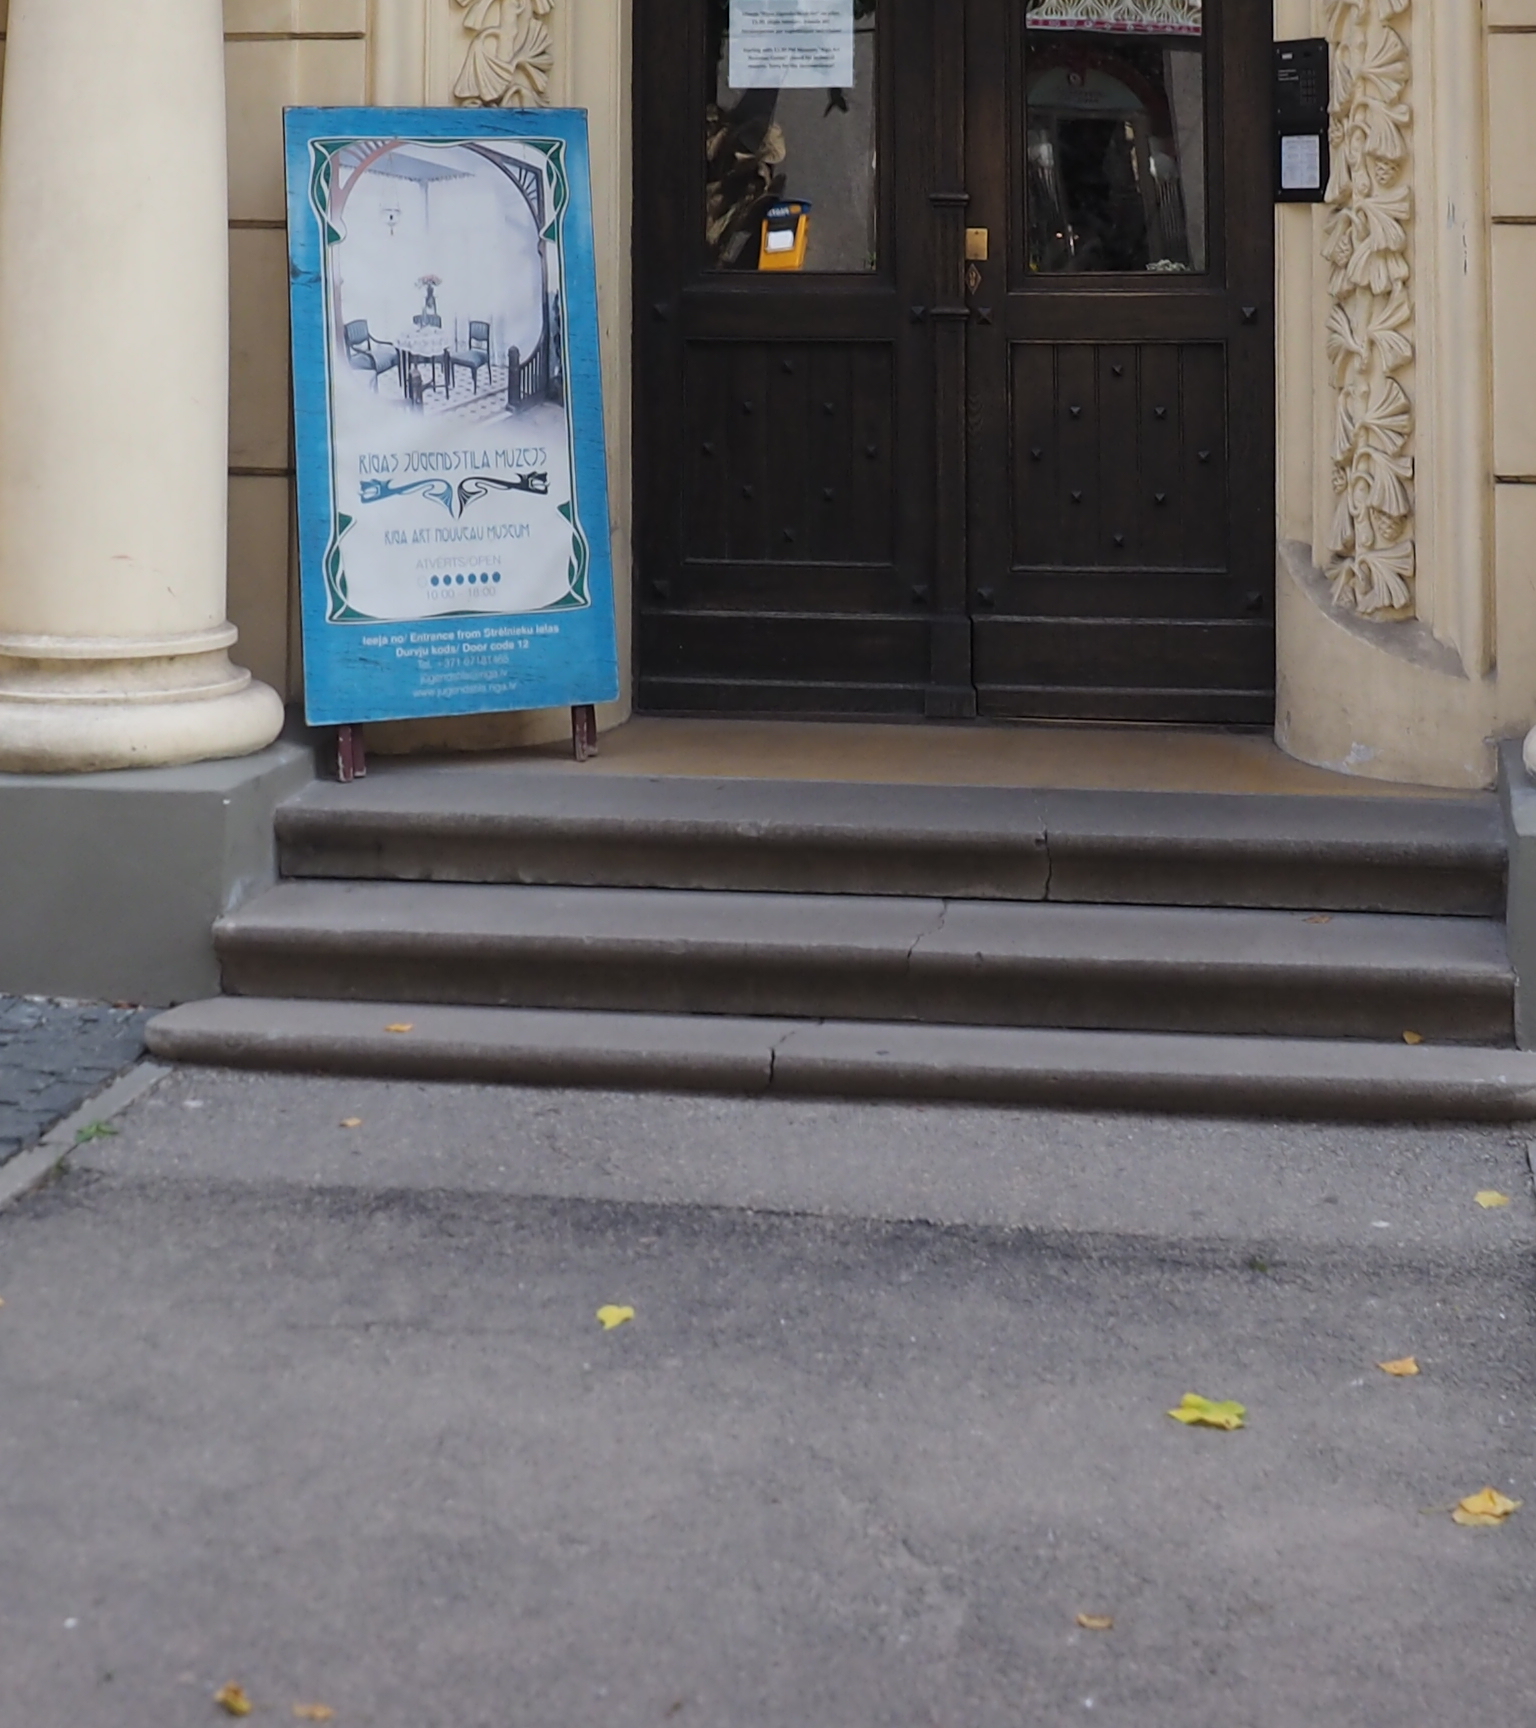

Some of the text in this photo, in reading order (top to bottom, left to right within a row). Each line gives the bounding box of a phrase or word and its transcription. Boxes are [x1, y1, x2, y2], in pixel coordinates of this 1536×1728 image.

[494, 447, 547, 468] MUZEJS
[412, 527, 431, 544] ART
[434, 525, 484, 543] NOUVEAU
[486, 523, 531, 540] MUSEUM
[410, 631, 454, 643] Entrance
[457, 629, 482, 640] from
[396, 647, 429, 658] Durvju
[462, 642, 488, 653] Door
[490, 640, 515, 651] code
[517, 638, 530, 649] 12
